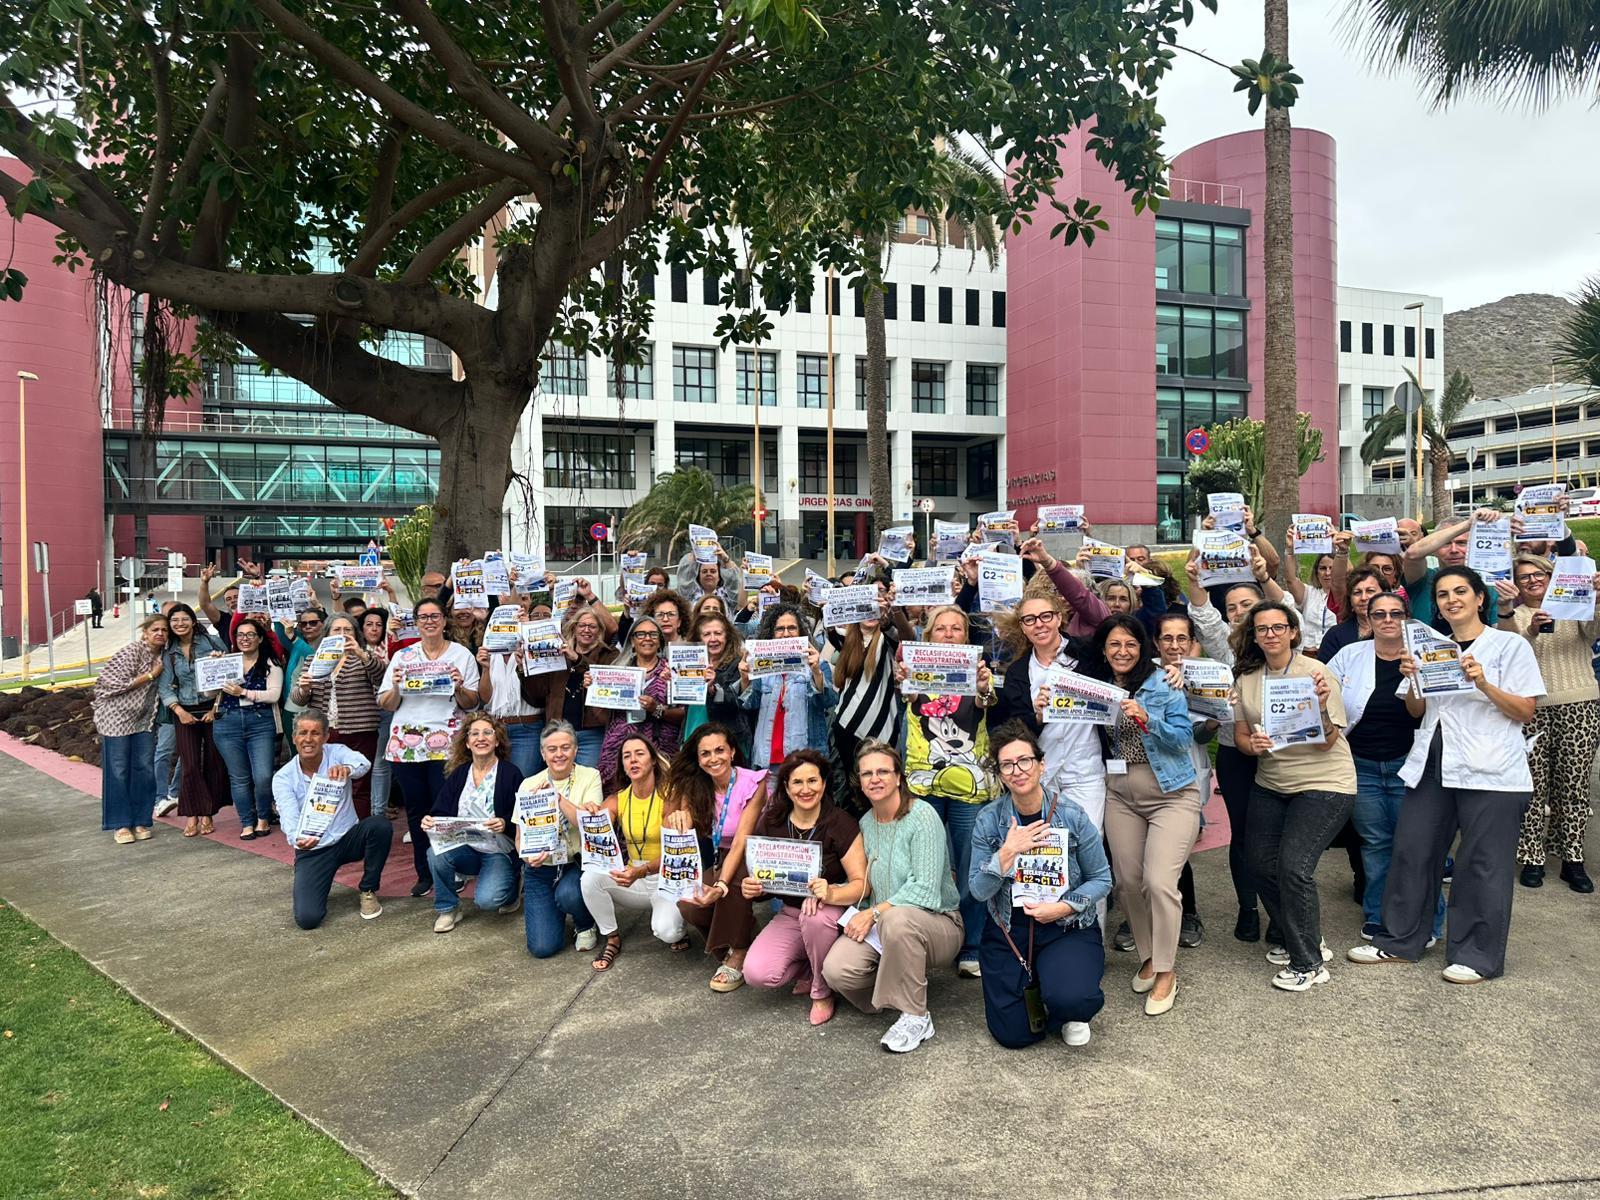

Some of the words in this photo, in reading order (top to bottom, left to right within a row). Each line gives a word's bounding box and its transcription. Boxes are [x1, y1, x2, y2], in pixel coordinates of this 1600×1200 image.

[1476, 541, 1492, 549] C2
[983, 571, 996, 580] C2
[832, 607, 844, 615] C2
[915, 649, 967, 658] RECLASIFICACIÓN
[1426, 653, 1437, 662] C2
[915, 673, 930, 681] C2
[1056, 698, 1071, 708] C2
[1271, 703, 1286, 713] C2
[1297, 700, 1312, 711] C1
[520, 797, 548, 806] AUXILIARES
[528, 818, 536, 826] C2
[546, 815, 555, 823] C1
[758, 843, 809, 853] RECLASIFICACIÓN
[755, 851, 804, 859] ADMINISTRATIVA
[757, 870, 772, 879] C2
[1023, 875, 1034, 883] C2
[1041, 877, 1050, 885] C1
